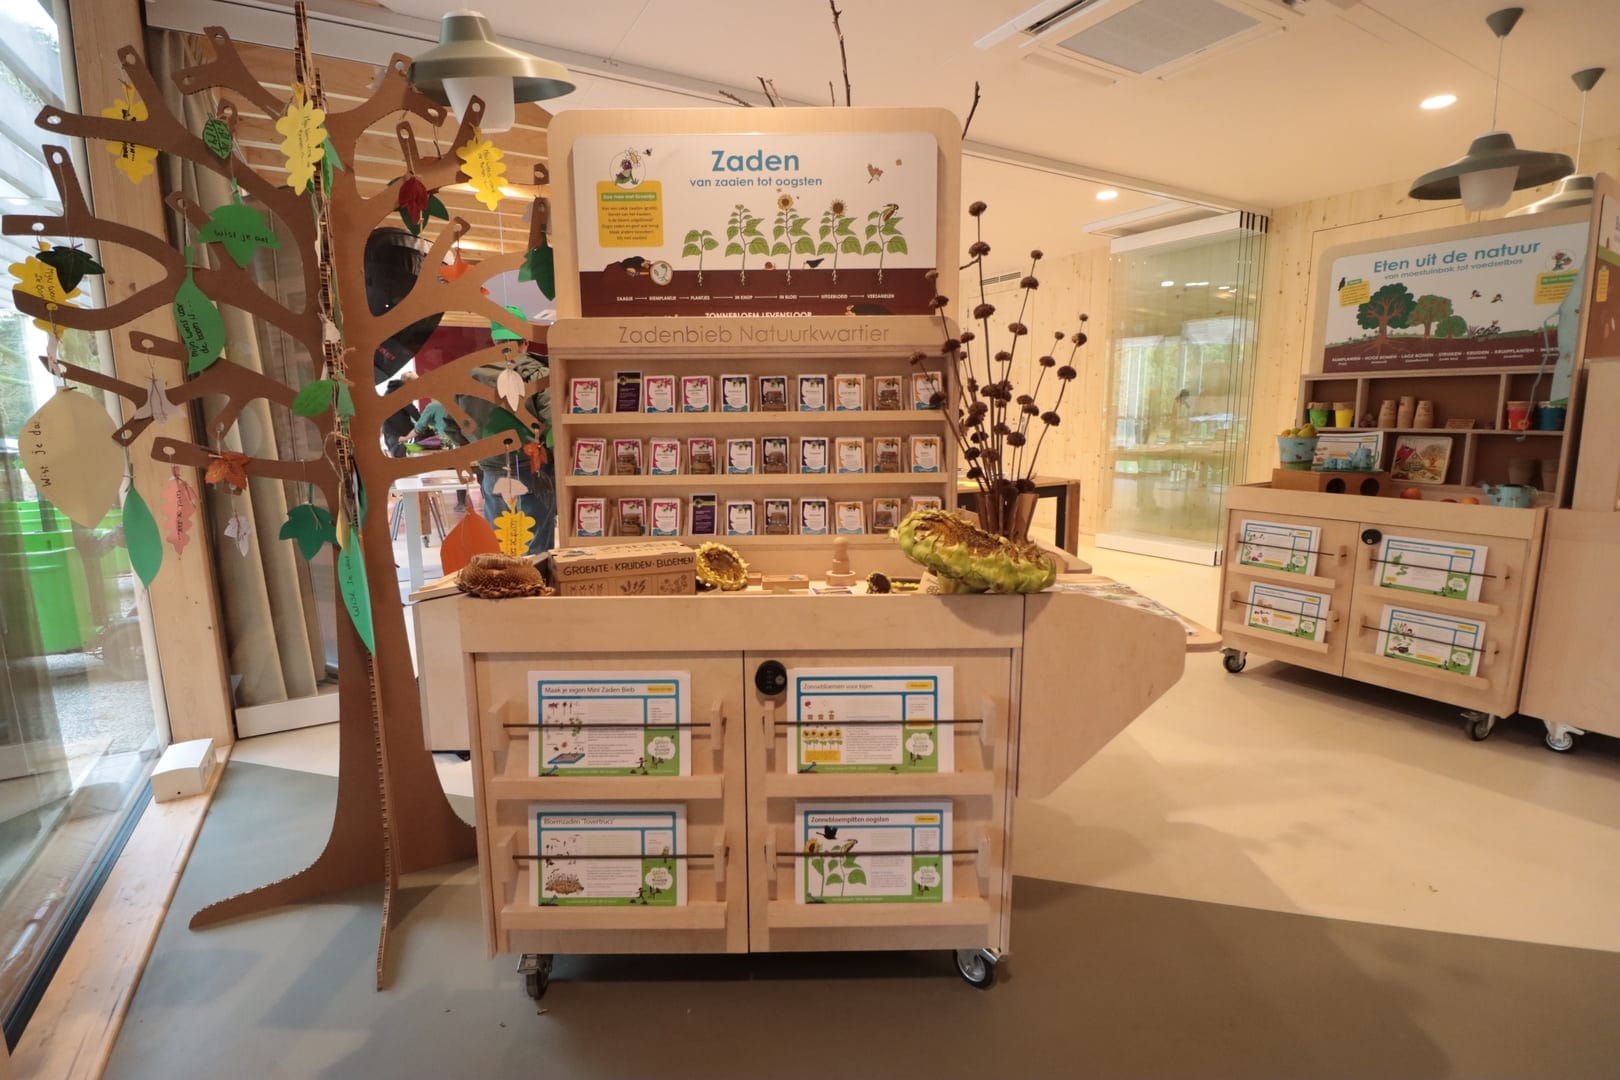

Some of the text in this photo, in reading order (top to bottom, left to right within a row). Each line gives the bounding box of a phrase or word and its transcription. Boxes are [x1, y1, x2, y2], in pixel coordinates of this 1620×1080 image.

[711, 149, 800, 173] Zaden
[689, 175, 823, 189] van zaaien tot oogsten
[1373, 241, 1541, 274] Eten uit de natuur
[1384, 273, 1400, 281] van
[1457, 264, 1470, 272] tot
[618, 324, 890, 344] Zadenbieb Natuurkwartier
[563, 557, 694, 576] GROENTE KRUIDEN BLOEMEN
[562, 687, 569, 695] je
